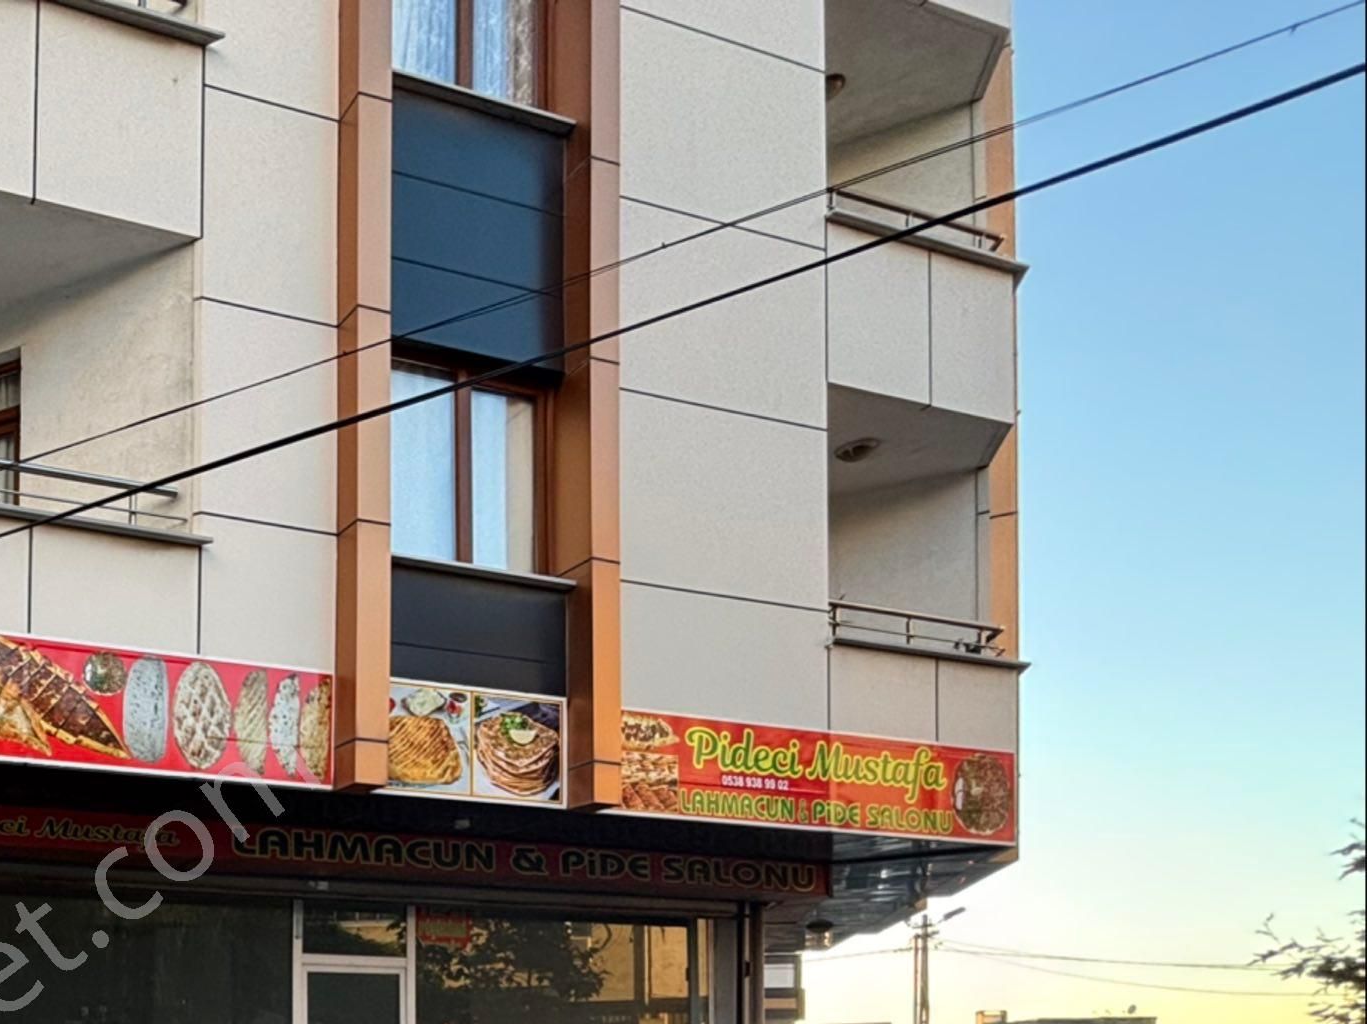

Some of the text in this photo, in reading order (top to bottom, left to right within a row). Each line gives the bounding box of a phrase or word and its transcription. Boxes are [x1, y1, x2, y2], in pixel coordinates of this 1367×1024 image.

[685, 727, 948, 804] Pideci Mustafa
[679, 787, 795, 822] LAHMACUN
[866, 803, 954, 834] SALONU
[231, 826, 497, 873] LAHMACUN
[509, 844, 548, 876] &
[659, 853, 819, 893] SALONU
